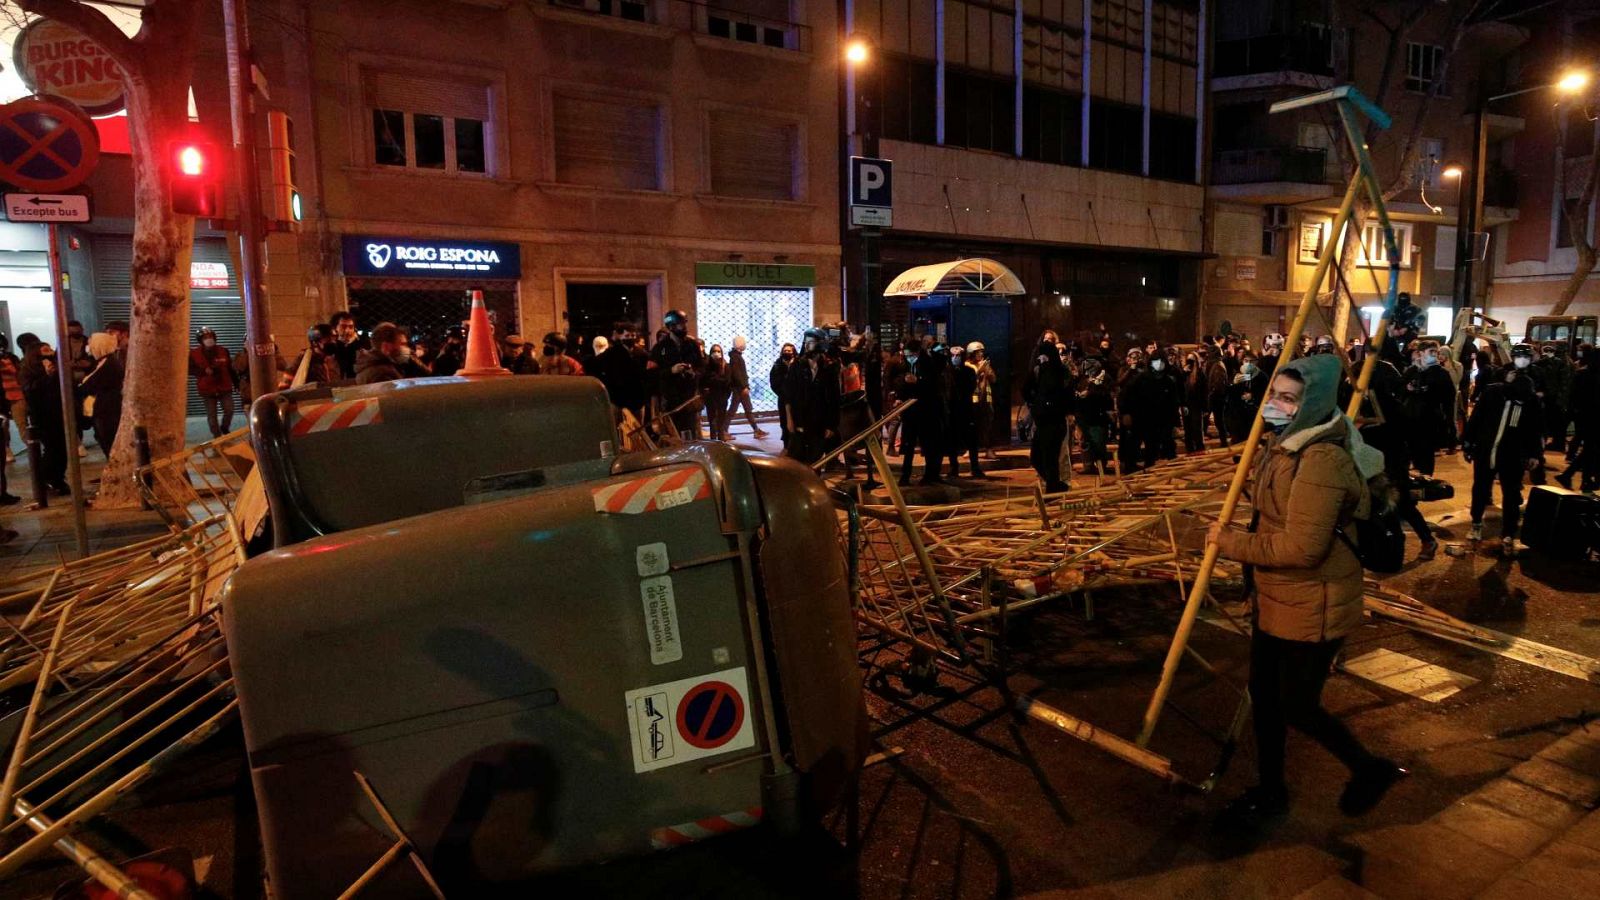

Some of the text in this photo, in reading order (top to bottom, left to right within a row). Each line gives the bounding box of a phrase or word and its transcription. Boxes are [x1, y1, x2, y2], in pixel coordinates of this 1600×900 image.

[28, 39, 105, 64] BURG
[35, 57, 122, 87] KING
[860, 163, 885, 200] P
[12, 206, 79, 217] Excepte bus
[395, 246, 500, 263] ROIG ESPONA
[722, 263, 785, 279] OUTLET
[647, 586, 656, 599] de
[657, 585, 674, 642] Ajuntament
